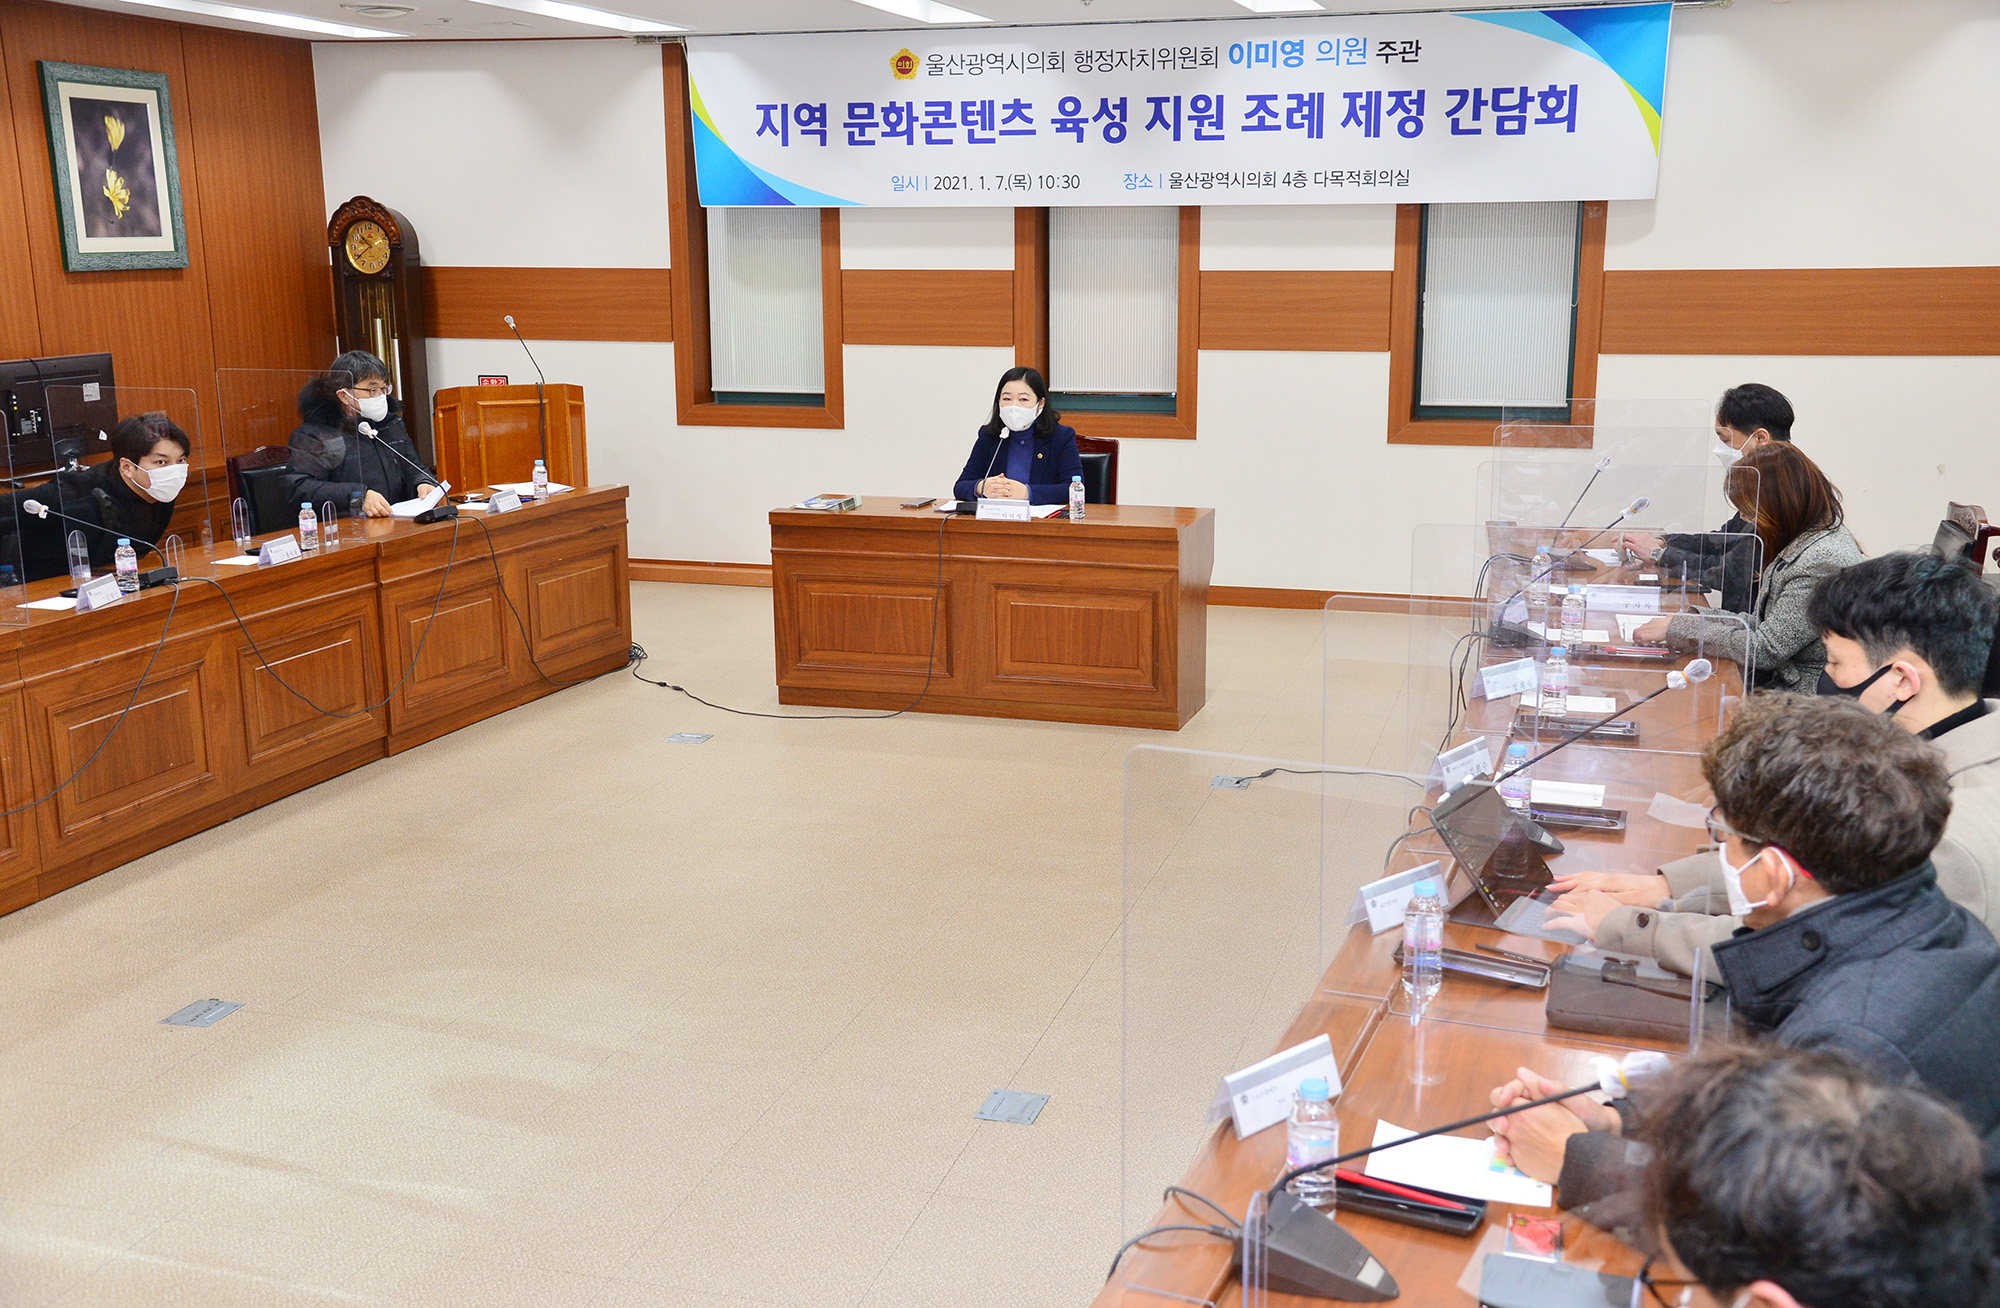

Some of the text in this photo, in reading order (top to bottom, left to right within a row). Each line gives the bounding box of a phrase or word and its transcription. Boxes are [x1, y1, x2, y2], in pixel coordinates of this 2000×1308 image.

[897, 60, 913, 69] 의회
[926, 37, 1422, 76] 울산광역시의회 행정자치위원회 이미영 의원 주관
[756, 84, 1578, 147] 지역 문화콘텐츠 육성 지원 조례 제정 간담회
[891, 176, 918, 191] 일시
[934, 176, 973, 191] 2021.
[1038, 175, 1080, 189] 10:30
[1124, 169, 1409, 190] 장소 울산광역시의회 4층 다목적회의실
